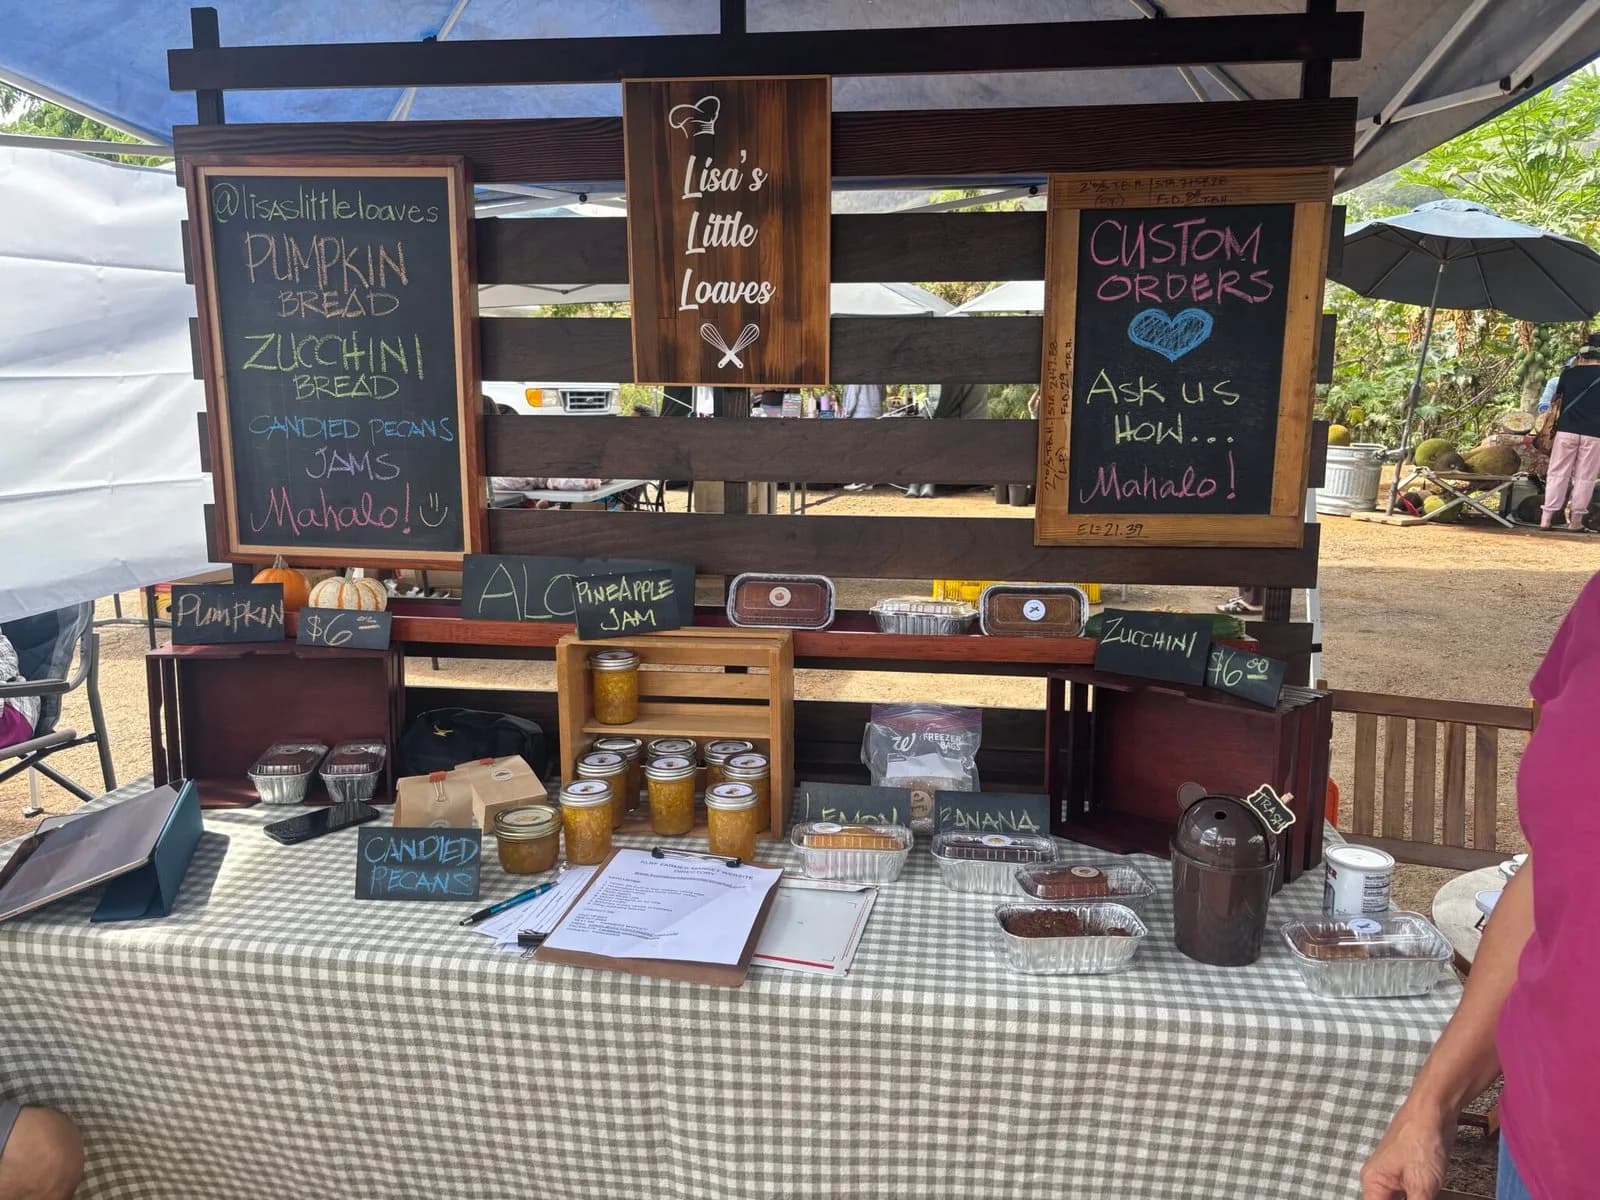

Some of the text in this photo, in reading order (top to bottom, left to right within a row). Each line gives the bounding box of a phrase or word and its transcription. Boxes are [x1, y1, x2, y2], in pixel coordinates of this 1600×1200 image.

[682, 150, 768, 200] Lisa's
[685, 211, 758, 255] Little
[1090, 218, 1263, 269] CUSTOM
[245, 231, 409, 294] PUMPKIN
[277, 288, 400, 318] BREAD
[678, 268, 777, 312] Loaves
[1097, 267, 1275, 304] ORDERS
[242, 331, 424, 381] ZUCCHINI
[293, 373, 400, 400] BREAD
[249, 415, 454, 446] CANDIED PECANS
[306, 446, 400, 480] JAMS
[1080, 450, 1236, 504] Mahalo!
[250, 481, 411, 535] Mahalo!
[575, 575, 674, 606] PINEAPPLE
[600, 607, 657, 632] JAM
[1100, 616, 1198, 658] ZUCCHINI
[1254, 791, 1287, 829] TRASH
[364, 835, 479, 866] CANDIED
[369, 864, 475, 896] PECANS
